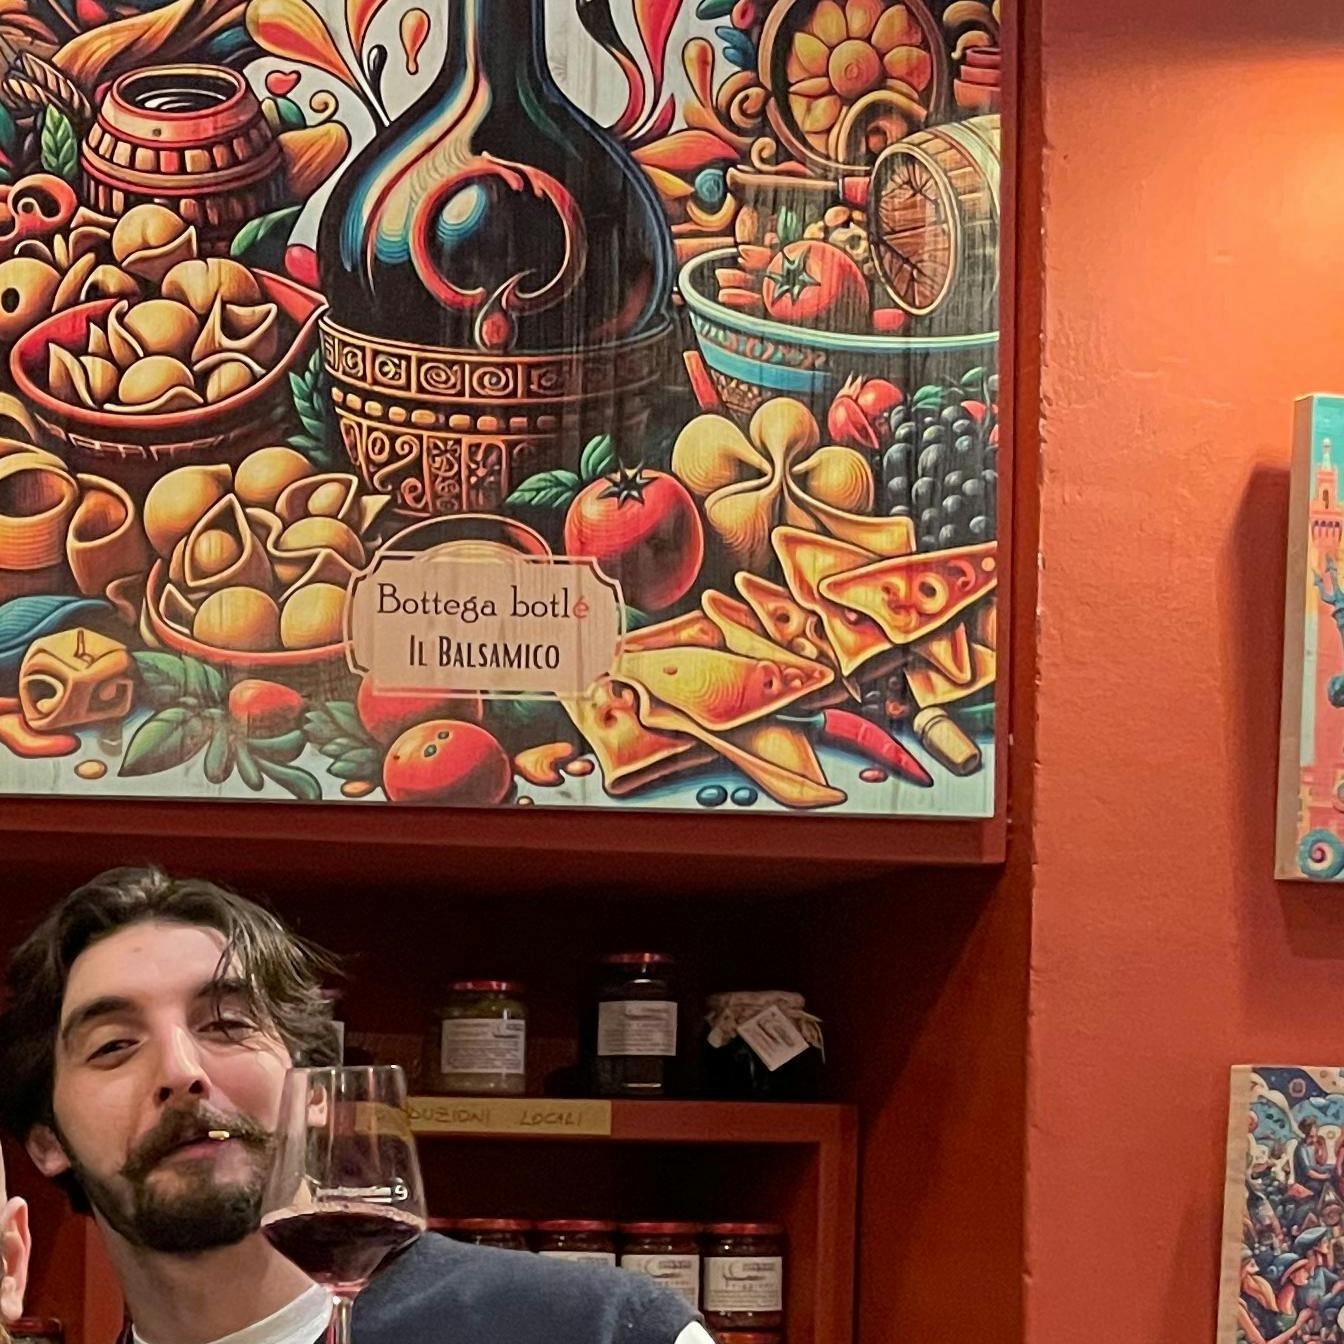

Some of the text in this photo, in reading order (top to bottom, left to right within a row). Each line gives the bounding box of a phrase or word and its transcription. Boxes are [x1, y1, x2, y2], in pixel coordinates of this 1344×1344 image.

[377, 583, 590, 624] Bottega botlé
[520, 1111, 583, 1127] LOCALI
